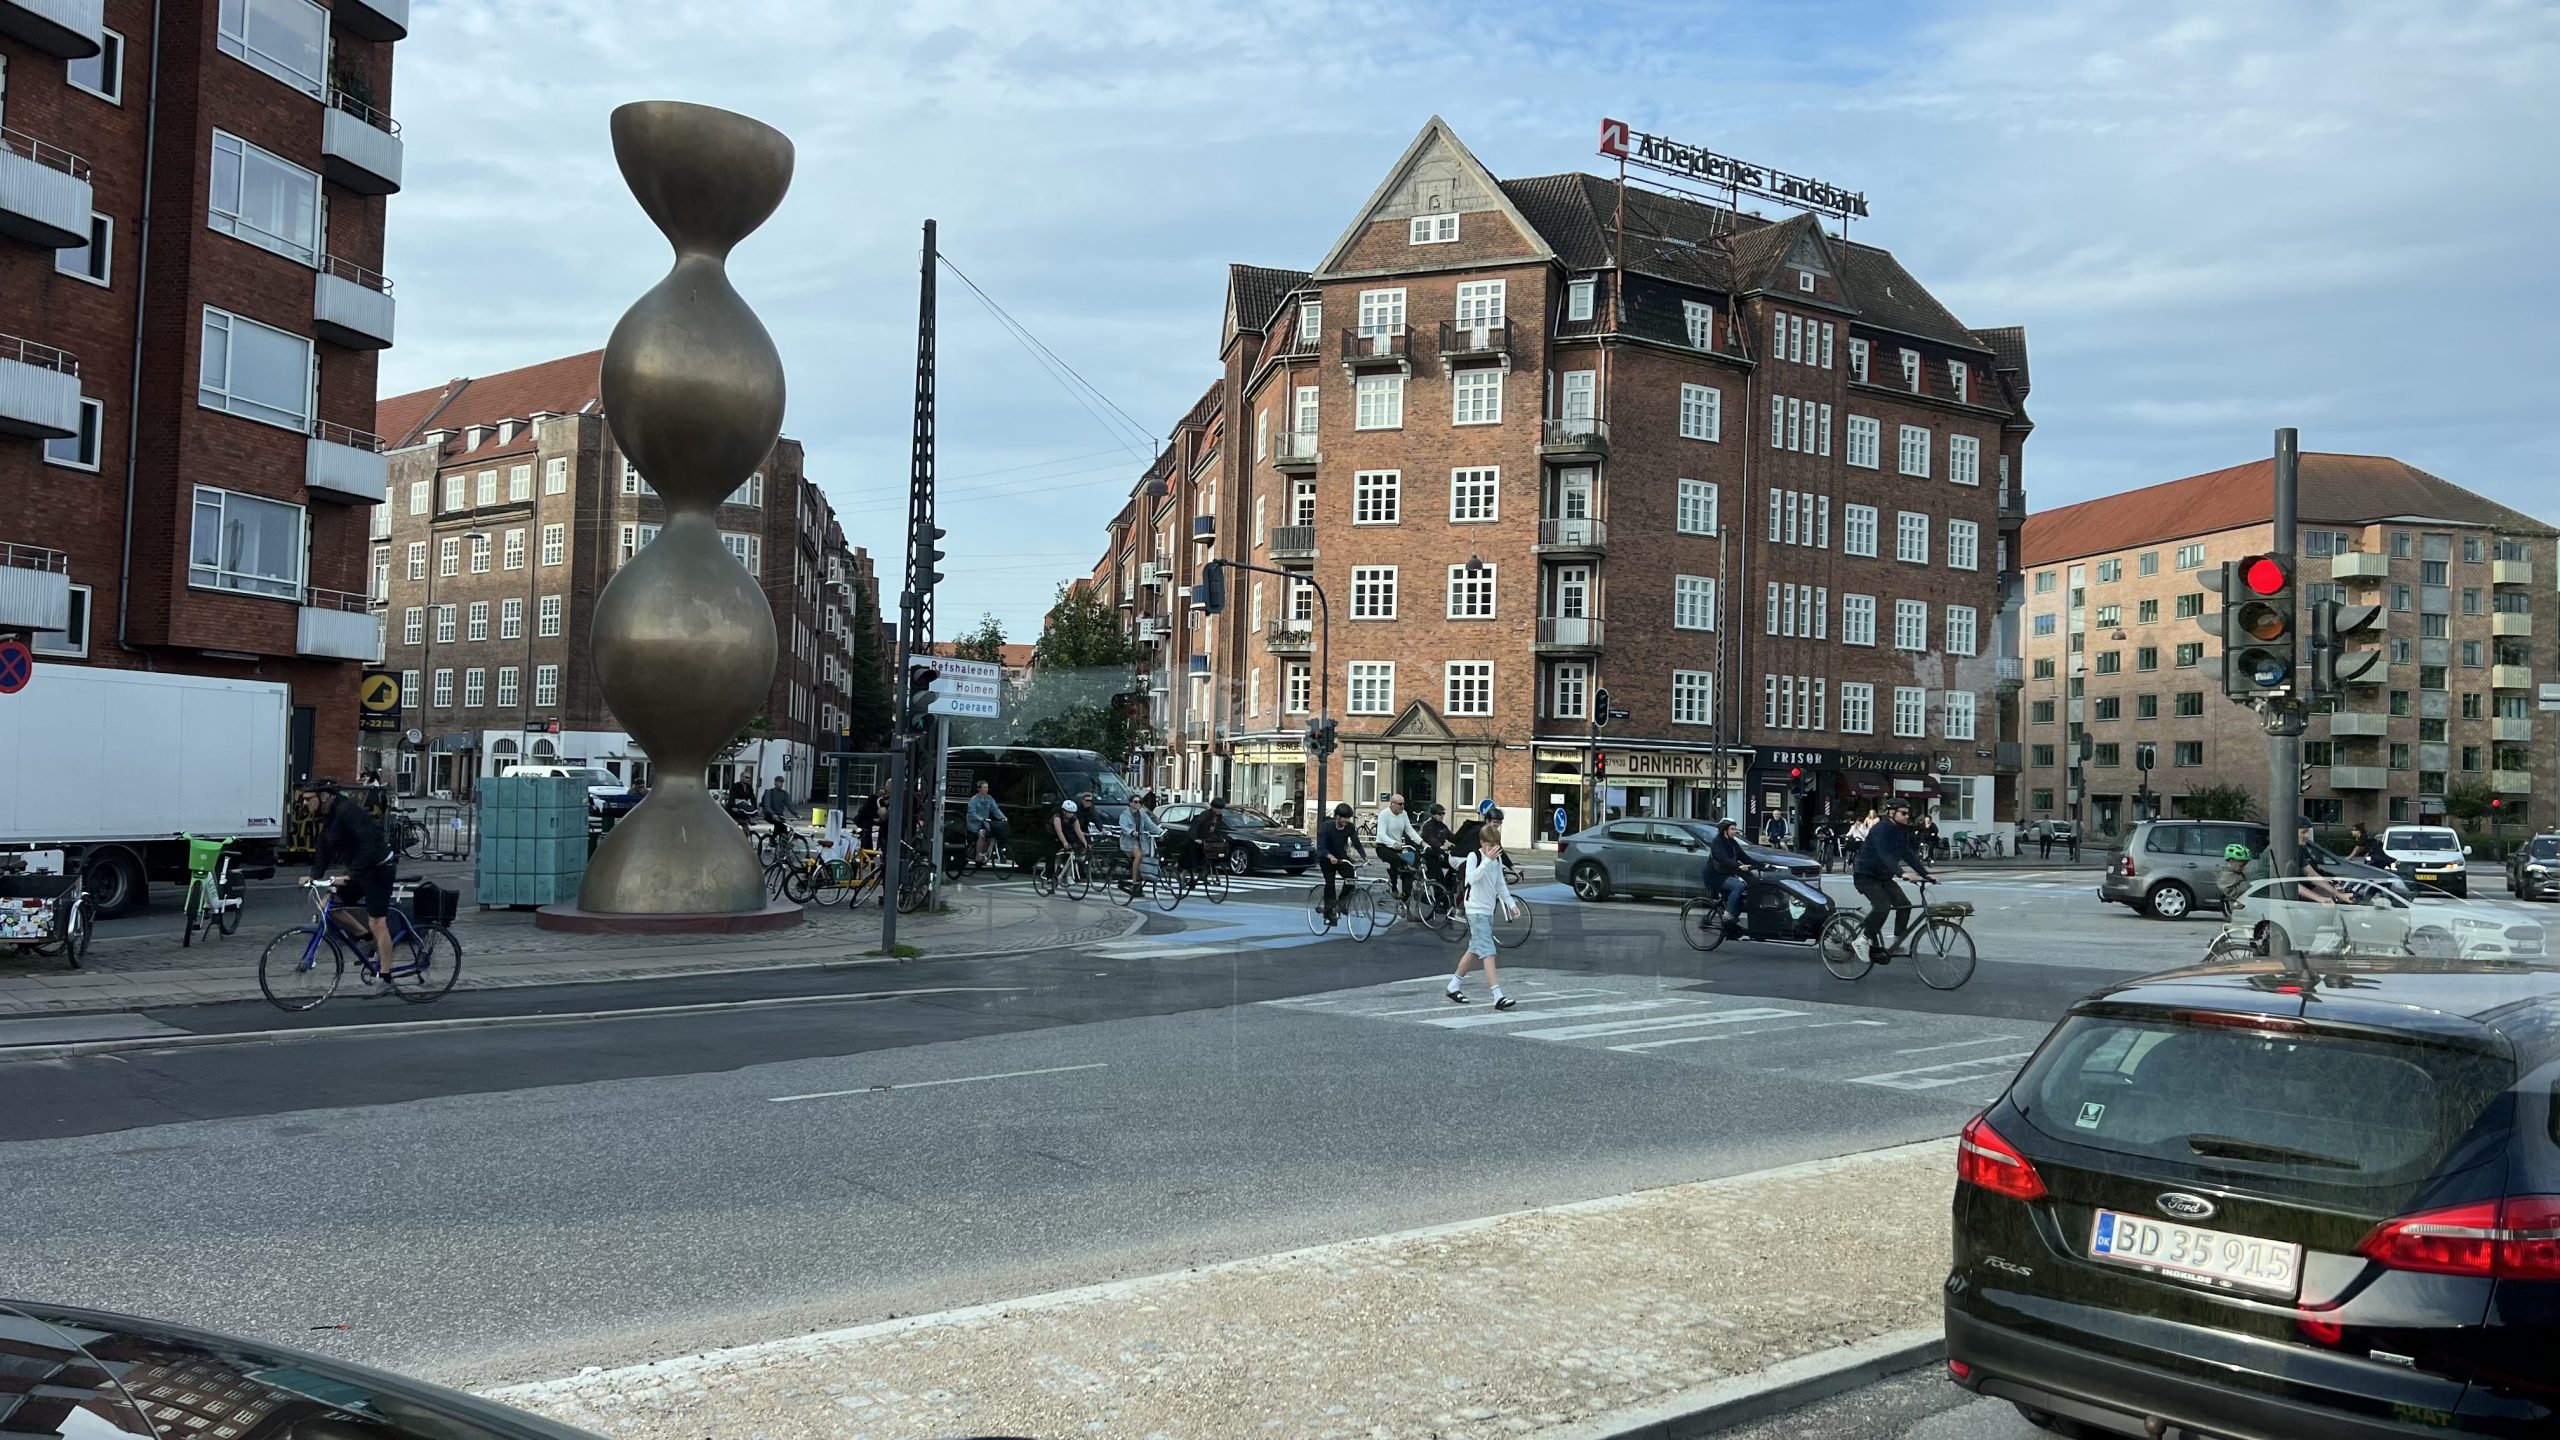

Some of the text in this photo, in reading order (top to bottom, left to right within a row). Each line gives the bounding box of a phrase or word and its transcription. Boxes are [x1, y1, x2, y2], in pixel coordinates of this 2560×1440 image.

[1638, 133, 1869, 217] Arbejdernes Landsbank
[931, 660, 995, 677] Refshaleøen
[956, 681, 994, 695] Holmen
[951, 700, 994, 713] Operaen
[1276, 741, 1301, 751] SENGE
[1628, 755, 1704, 775] DANMARK
[1846, 755, 1918, 772] Vinstuen
[2167, 1197, 2201, 1214] Ford
[2097, 1236, 2110, 1247] DK
[2116, 1220, 2291, 1281] BD 35 915
